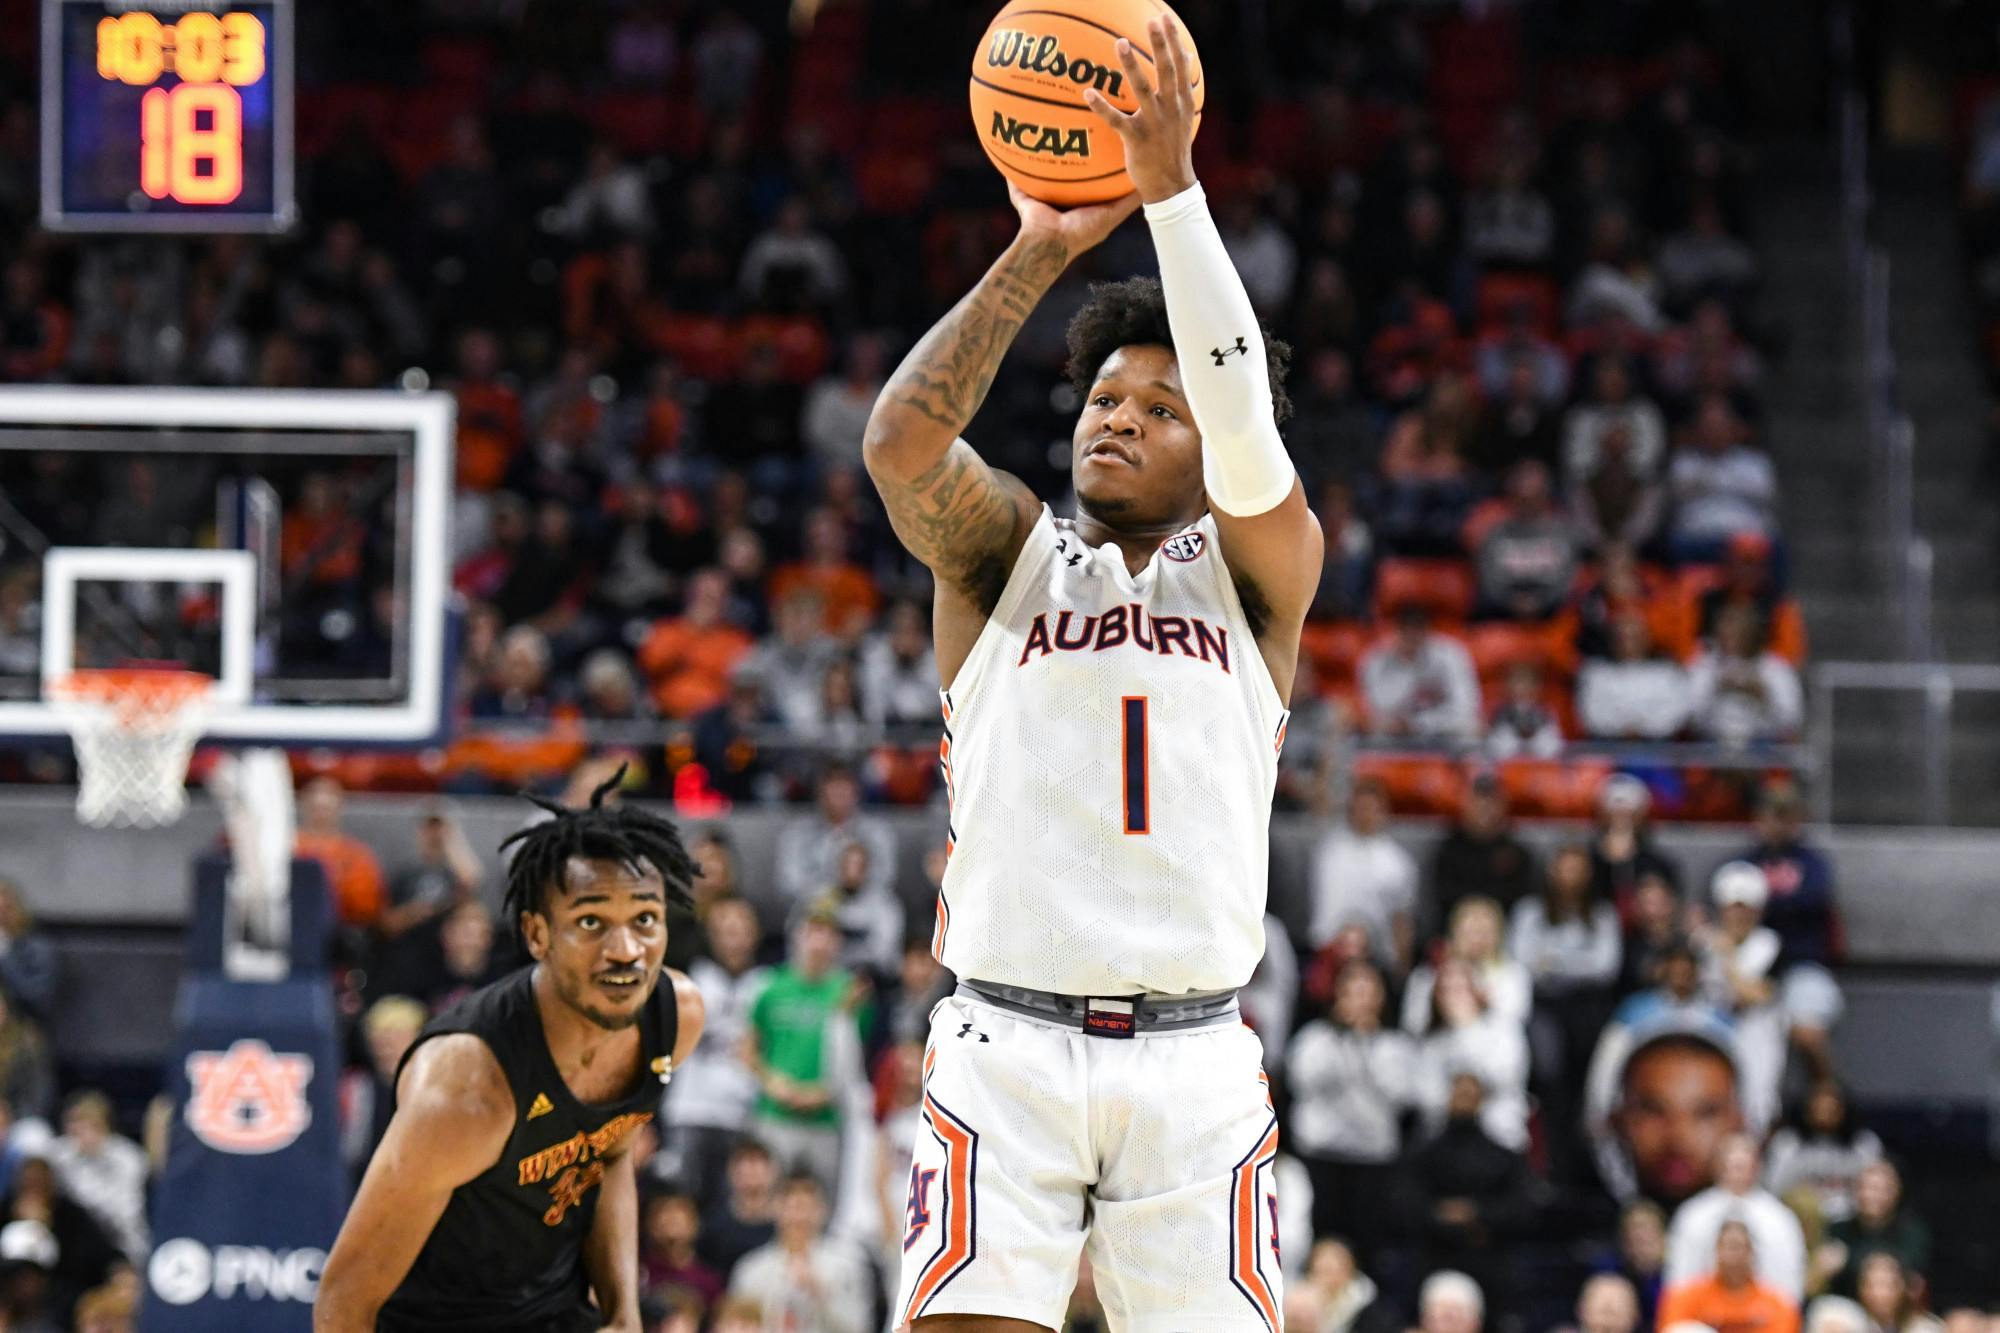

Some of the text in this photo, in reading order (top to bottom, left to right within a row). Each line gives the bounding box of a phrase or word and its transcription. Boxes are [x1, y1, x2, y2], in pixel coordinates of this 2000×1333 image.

[97, 12, 265, 85] 10:03
[988, 28, 1123, 97] Wilson
[141, 82, 242, 204] 18
[991, 110, 1090, 157] NCAA
[1163, 533, 1203, 560] SEC
[1018, 603, 1231, 674] AUBURN
[1122, 696, 1149, 835] 1
